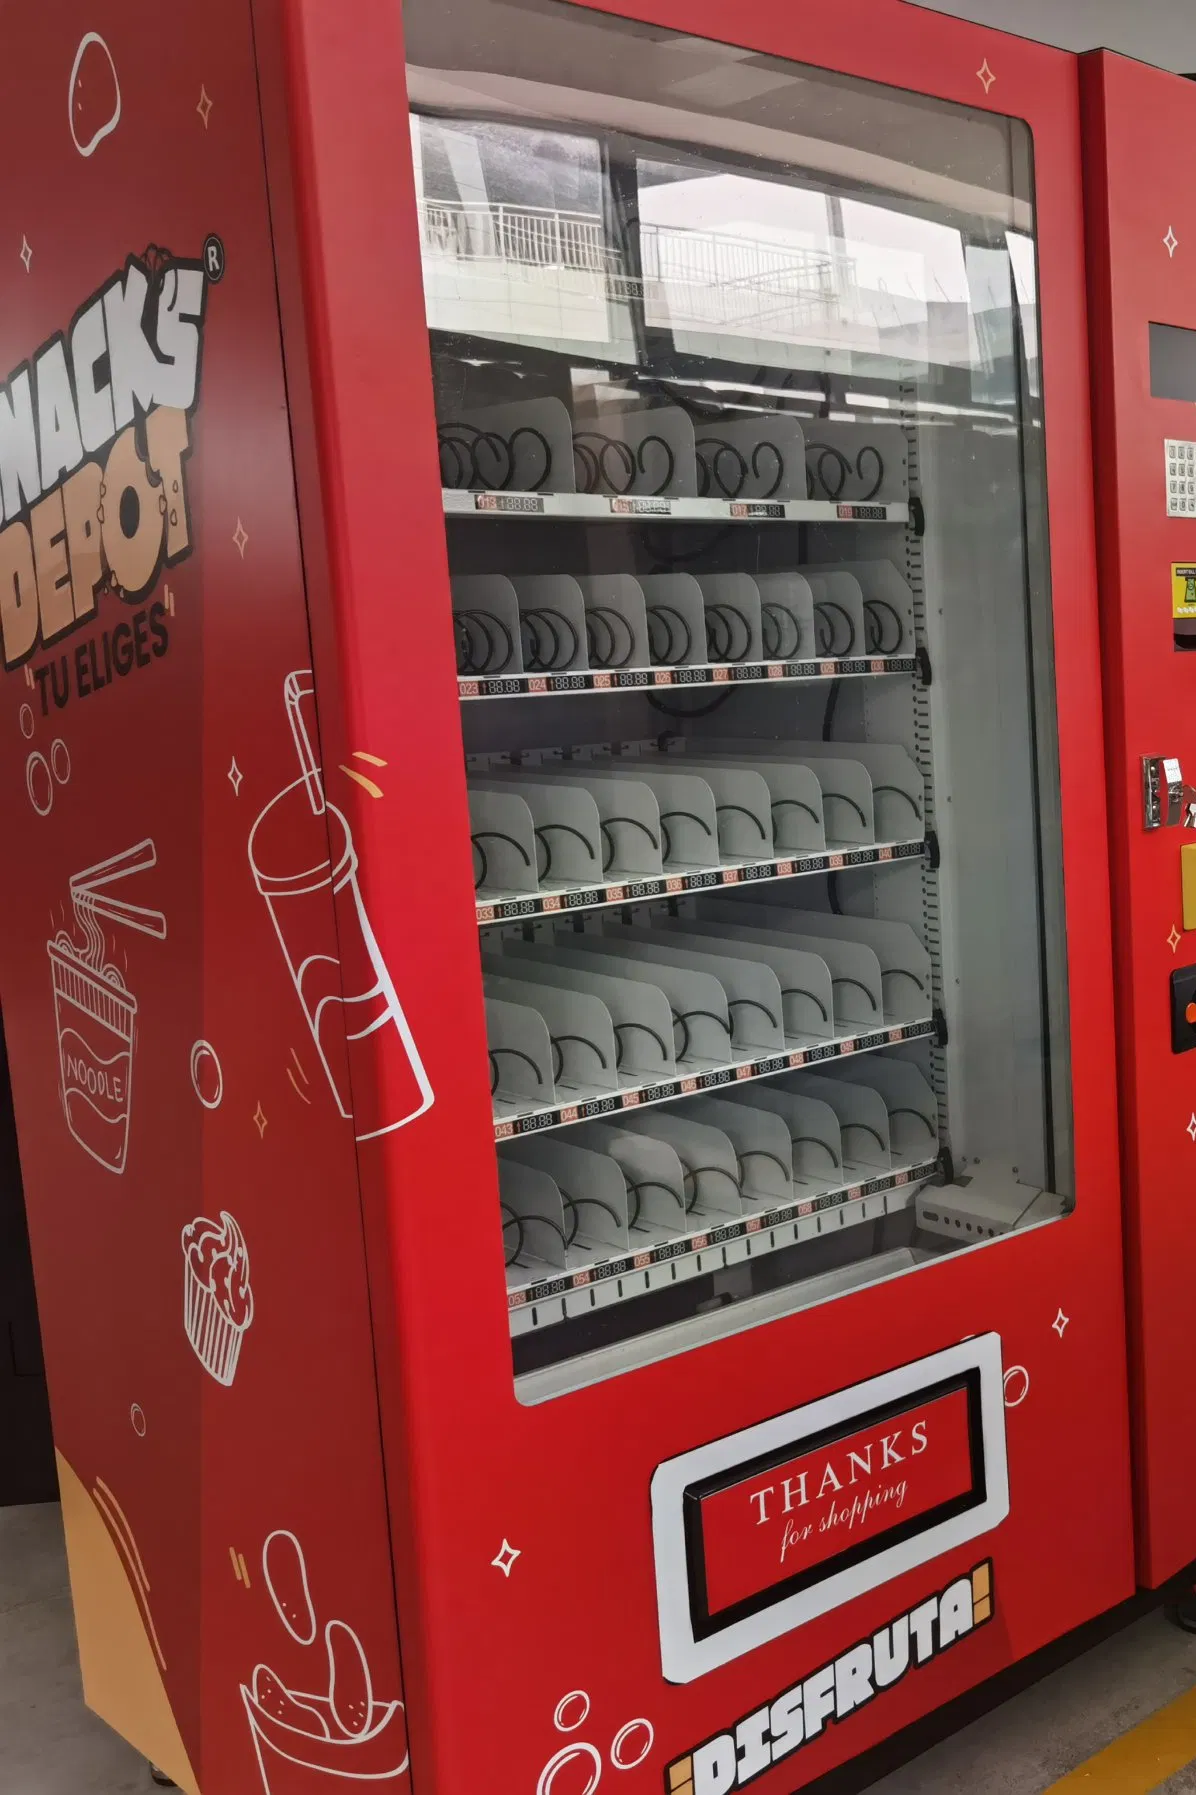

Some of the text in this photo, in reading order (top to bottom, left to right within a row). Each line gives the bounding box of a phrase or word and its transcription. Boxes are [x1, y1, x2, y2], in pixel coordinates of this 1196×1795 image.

[0, 262, 205, 524] NACKS
[0, 403, 191, 665] DEPOT
[34, 602, 170, 716] TU ELIGES
[768, 666, 783, 677] 028
[821, 662, 835, 673] 029
[655, 672, 672, 684] 026
[712, 668, 728, 680] 027
[528, 678, 547, 690] 024
[594, 675, 611, 687] 025
[460, 683, 478, 695] 023
[829, 856, 843, 867] 039
[777, 863, 792, 874] 038
[723, 870, 738, 882] 037
[666, 879, 682, 891] 036
[606, 887, 623, 900] 035
[543, 897, 561, 910] 034
[476, 907, 494, 920] 033
[789, 1053, 804, 1065] 048
[66, 1054, 124, 1103] NOODLE
[736, 1066, 751, 1079] 047
[681, 1079, 697, 1092] 046
[623, 1093, 640, 1105] 045
[560, 1108, 578, 1121] 044
[495, 1123, 513, 1137] 043
[798, 1203, 812, 1215] 058
[746, 1220, 761, 1232] 057
[692, 1237, 708, 1249] 056
[634, 1254, 650, 1267] 055
[573, 1273, 590, 1286] 054
[508, 1293, 526, 1306] 053
[750, 1420, 930, 1526] THANKS
[780, 1477, 909, 1563] for shopping
